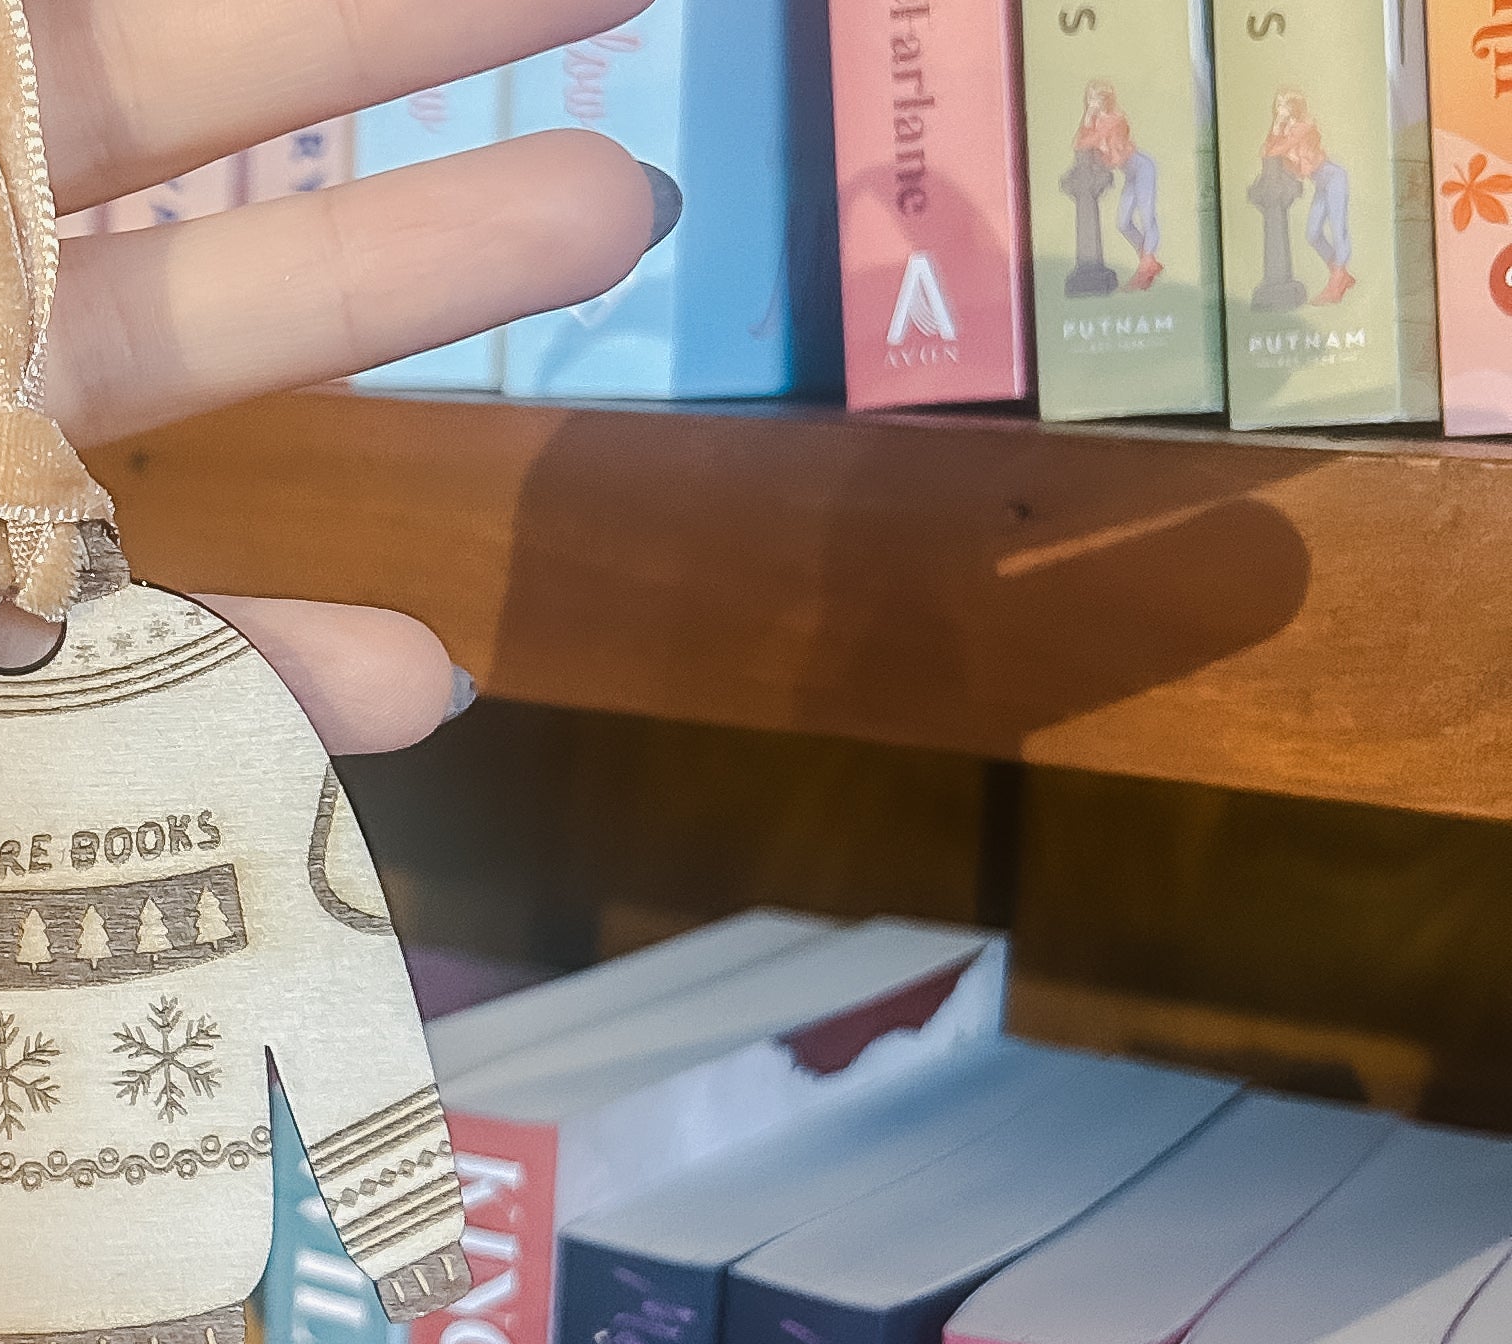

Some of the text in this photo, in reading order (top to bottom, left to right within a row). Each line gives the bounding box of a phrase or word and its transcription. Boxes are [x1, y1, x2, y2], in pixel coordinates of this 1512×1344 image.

[1062, 314, 1176, 340] PUTNAM
[1247, 328, 1367, 355] PUTNAM
[71, 810, 221, 870] BOOKS
